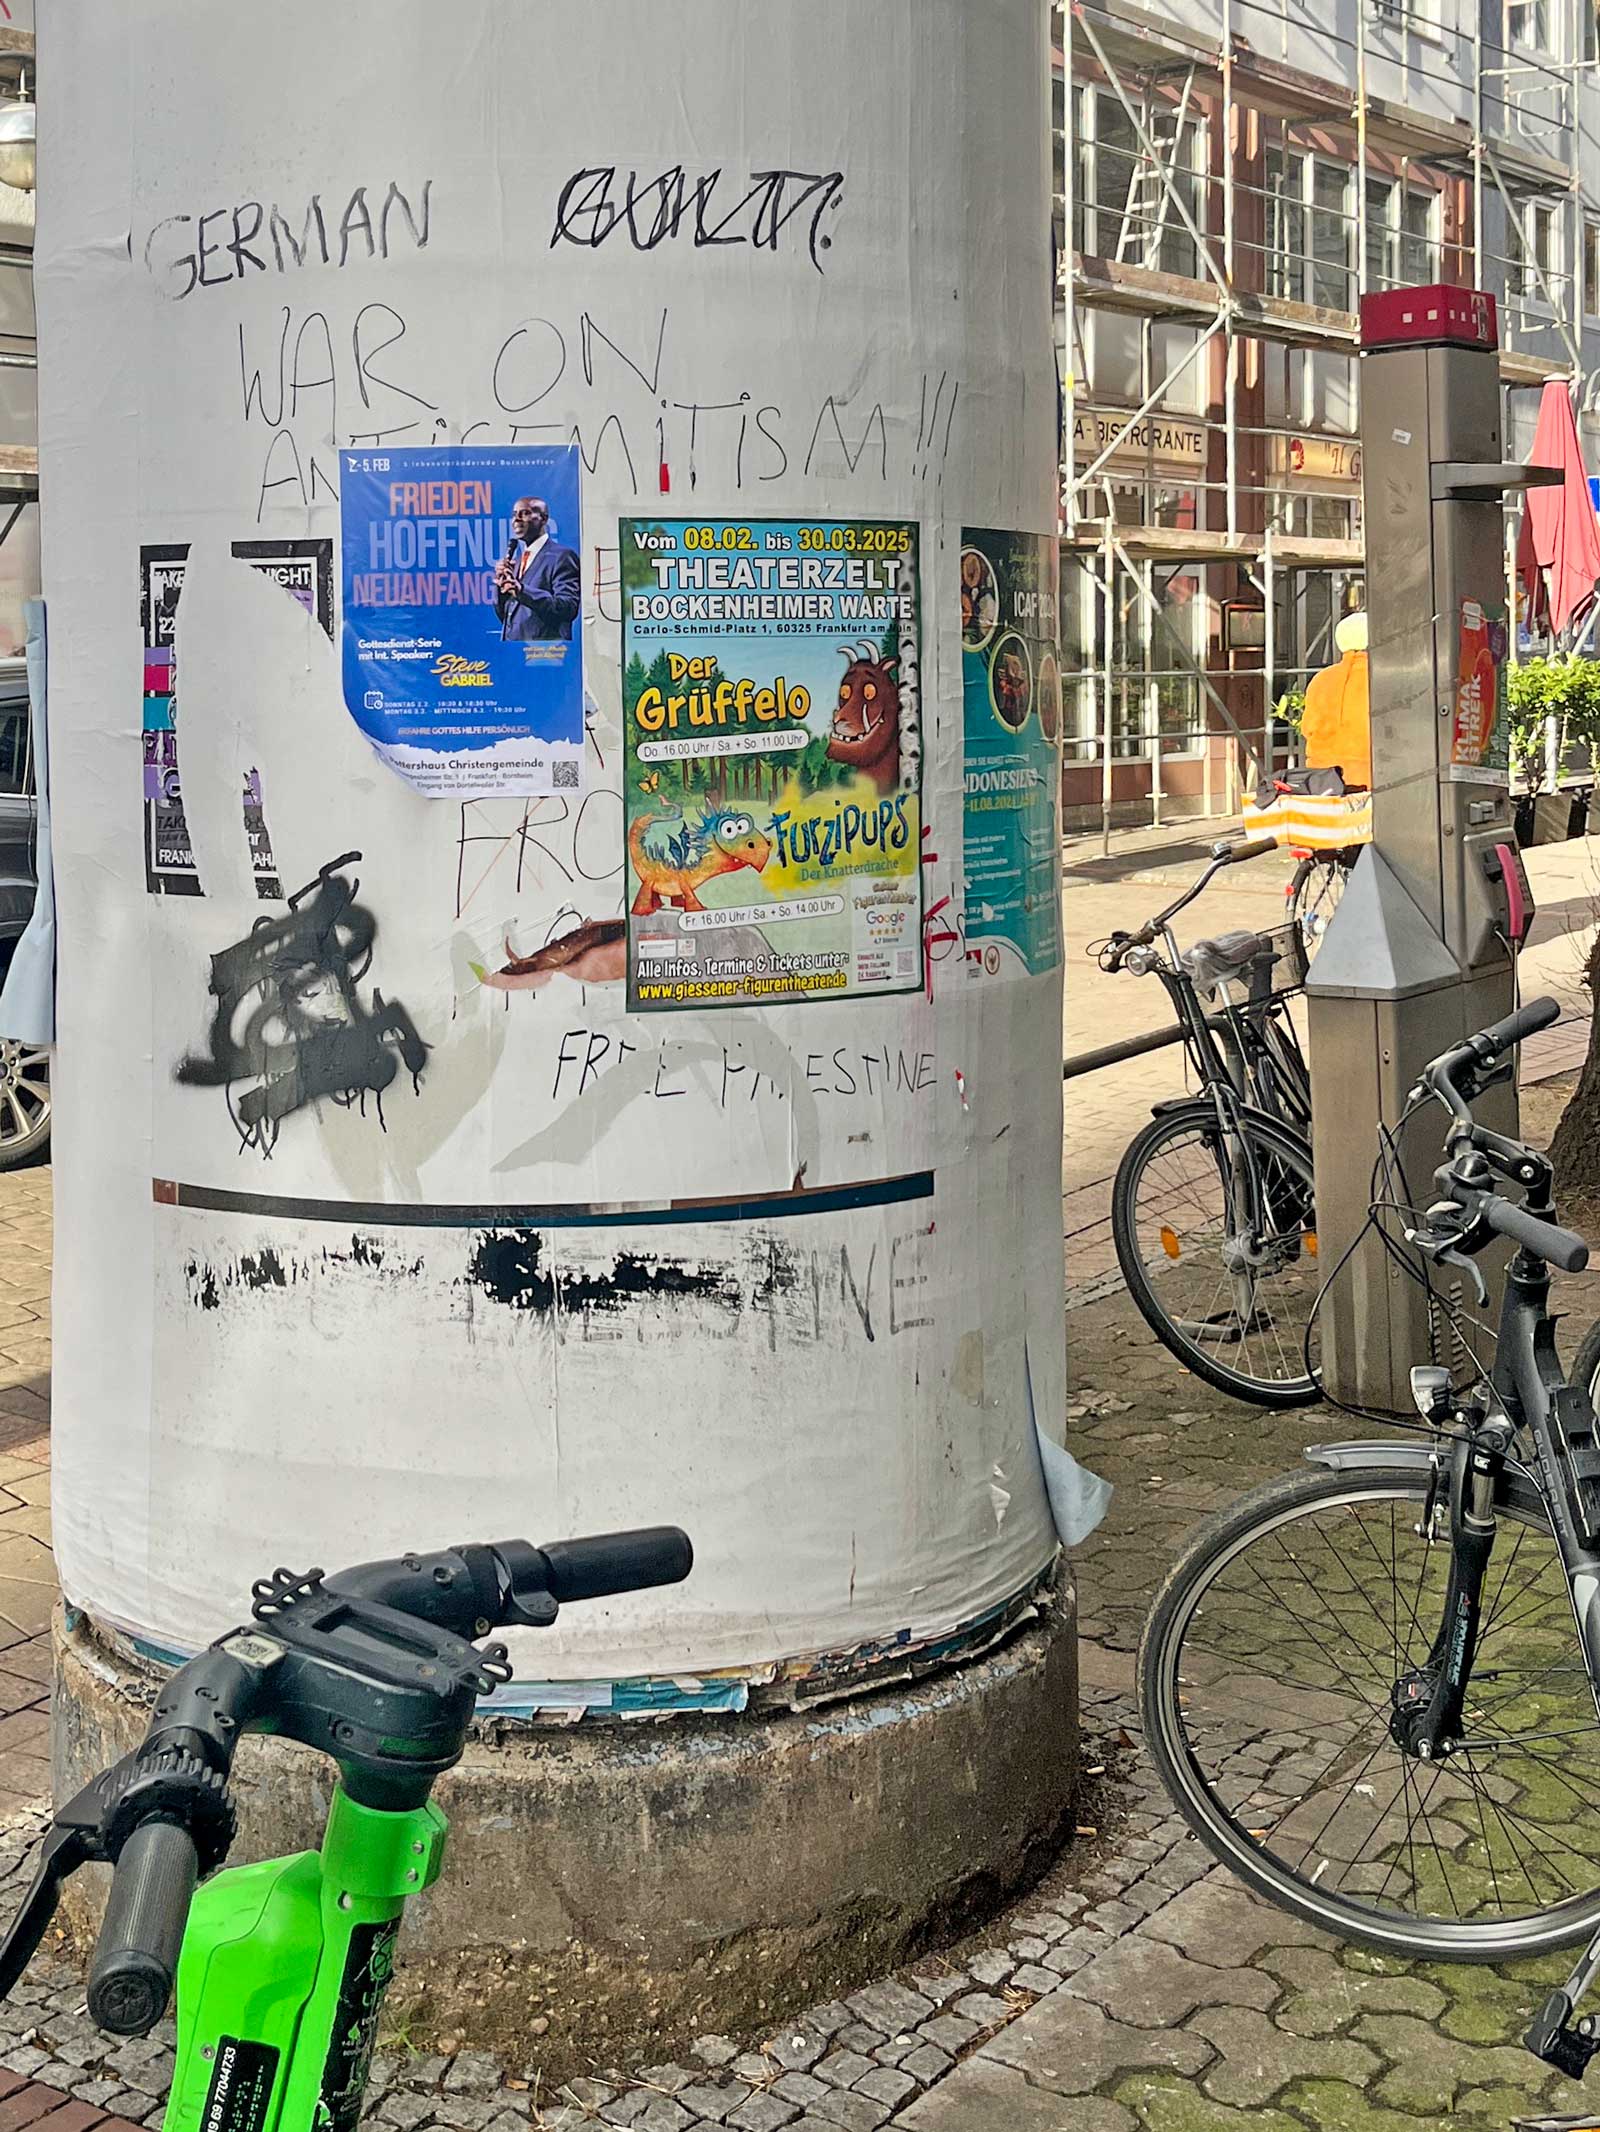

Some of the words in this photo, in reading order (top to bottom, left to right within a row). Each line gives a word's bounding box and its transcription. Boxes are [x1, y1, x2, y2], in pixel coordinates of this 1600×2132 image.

[144, 179, 431, 301] GERMAN
[239, 303, 440, 440] WAR
[494, 308, 667, 412] ON
[373, 458, 391, 472] FEB
[389, 481, 492, 516] FRIEDEN
[369, 518, 559, 569] HOFFNU
[634, 532, 676, 549] Vom
[684, 527, 759, 550] 08.02.
[765, 532, 792, 550] bis
[798, 527, 910, 552] 30.03.2025
[651, 558, 901, 590] THEATERZELT
[353, 572, 499, 607] NEUANFANG
[632, 595, 834, 620] BOCKENHEIMER
[840, 594, 912, 619] WARTE
[1013, 591, 1038, 618] ICAF
[633, 623, 757, 635] Carlo-Schmid-Platz
[776, 624, 812, 634] 60325
[816, 623, 868, 633] Frankfurt
[870, 625, 886, 633] am
[358, 638, 442, 650] Gottesdienst-Serie
[358, 651, 374, 661] mit
[391, 650, 434, 661] Speaker:
[430, 654, 491, 674] Steve
[667, 652, 716, 681] Der
[440, 674, 494, 687] GABRIEL
[635, 677, 811, 731] Grüffelo
[432, 726, 461, 735] GOTTES
[462, 726, 482, 734] HILFE
[483, 723, 530, 734] PERSÖNLICH
[1455, 683, 1470, 761] KLIMA
[1469, 673, 1481, 762] STREIK
[692, 742, 710, 754] Uhr
[787, 734, 803, 745] Uhr
[449, 758, 544, 771] Christengemeinde
[801, 868, 821, 882] Der
[823, 859, 899, 879] Knatterdrache
[701, 912, 726, 925] 16.00
[728, 911, 746, 923] Uhr
[796, 903, 819, 915] 14.00
[820, 900, 836, 912] Uhr
[866, 909, 905, 926] Google
[637, 959, 662, 979] Alle
[664, 957, 702, 977] Infos,
[704, 955, 754, 976] Termine
[756, 956, 766, 973] &
[768, 953, 813, 973] Tickets
[814, 953, 850, 971] unter:
[638, 970, 848, 1000] www.giessener-figurentheater.de
[1533, 1429, 1569, 1538] GUDEREIT
[214, 2046, 236, 2103] 77044733
[210, 2104, 223, 2121] 69
